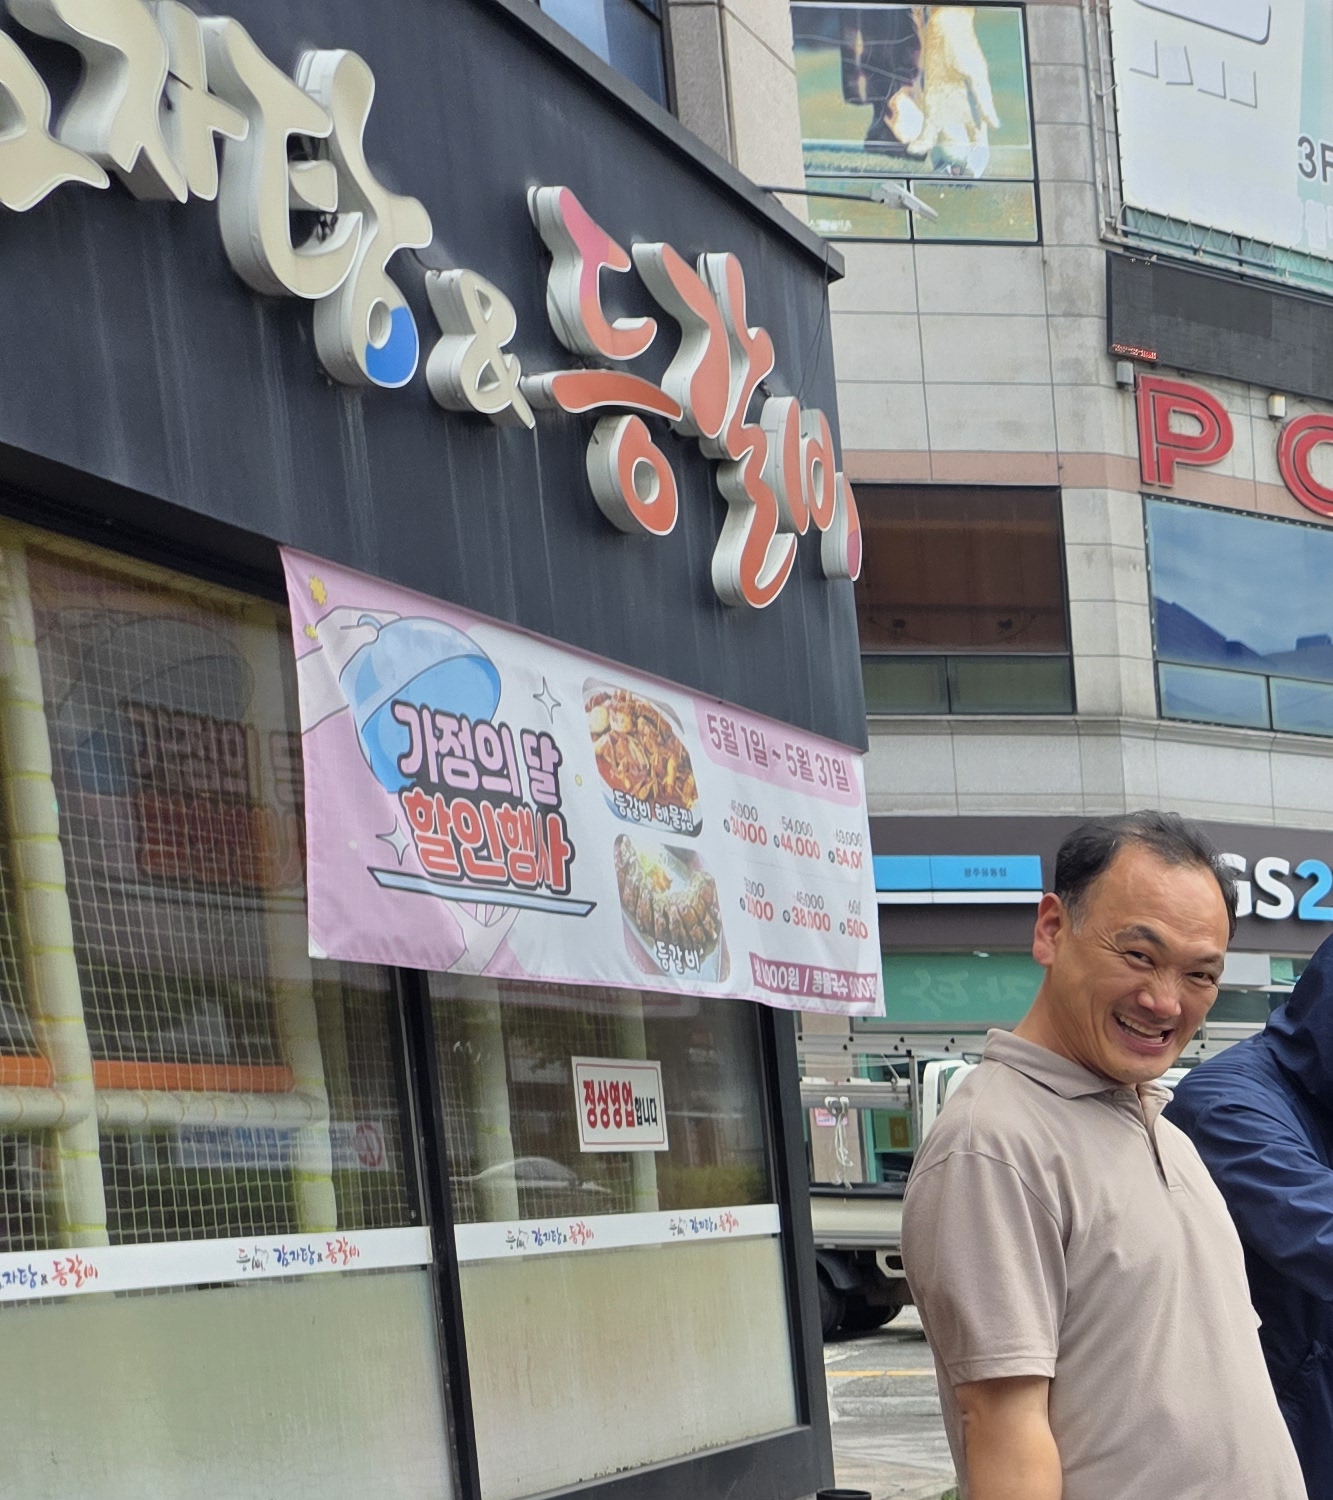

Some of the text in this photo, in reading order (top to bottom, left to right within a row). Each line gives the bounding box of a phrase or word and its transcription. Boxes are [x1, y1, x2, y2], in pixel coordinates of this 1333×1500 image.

[434, 267, 536, 430] &
[391, 700, 560, 806] 가정의 달
[707, 713, 740, 758] 5월
[740, 726, 769, 768] 1일
[784, 742, 815, 783] 5월
[814, 752, 851, 793] 31일
[613, 789, 695, 834] 등갈비 해물찜
[401, 787, 572, 891] 할인행사
[656, 941, 704, 976] 등갈비
[272, 1244, 315, 1267] 감자탕
[325, 1236, 361, 1267] 등갈비
[568, 1221, 596, 1246] 등갈비
[0, 1267, 38, 1290] 자탕
[51, 1253, 99, 1289] 등갈비
